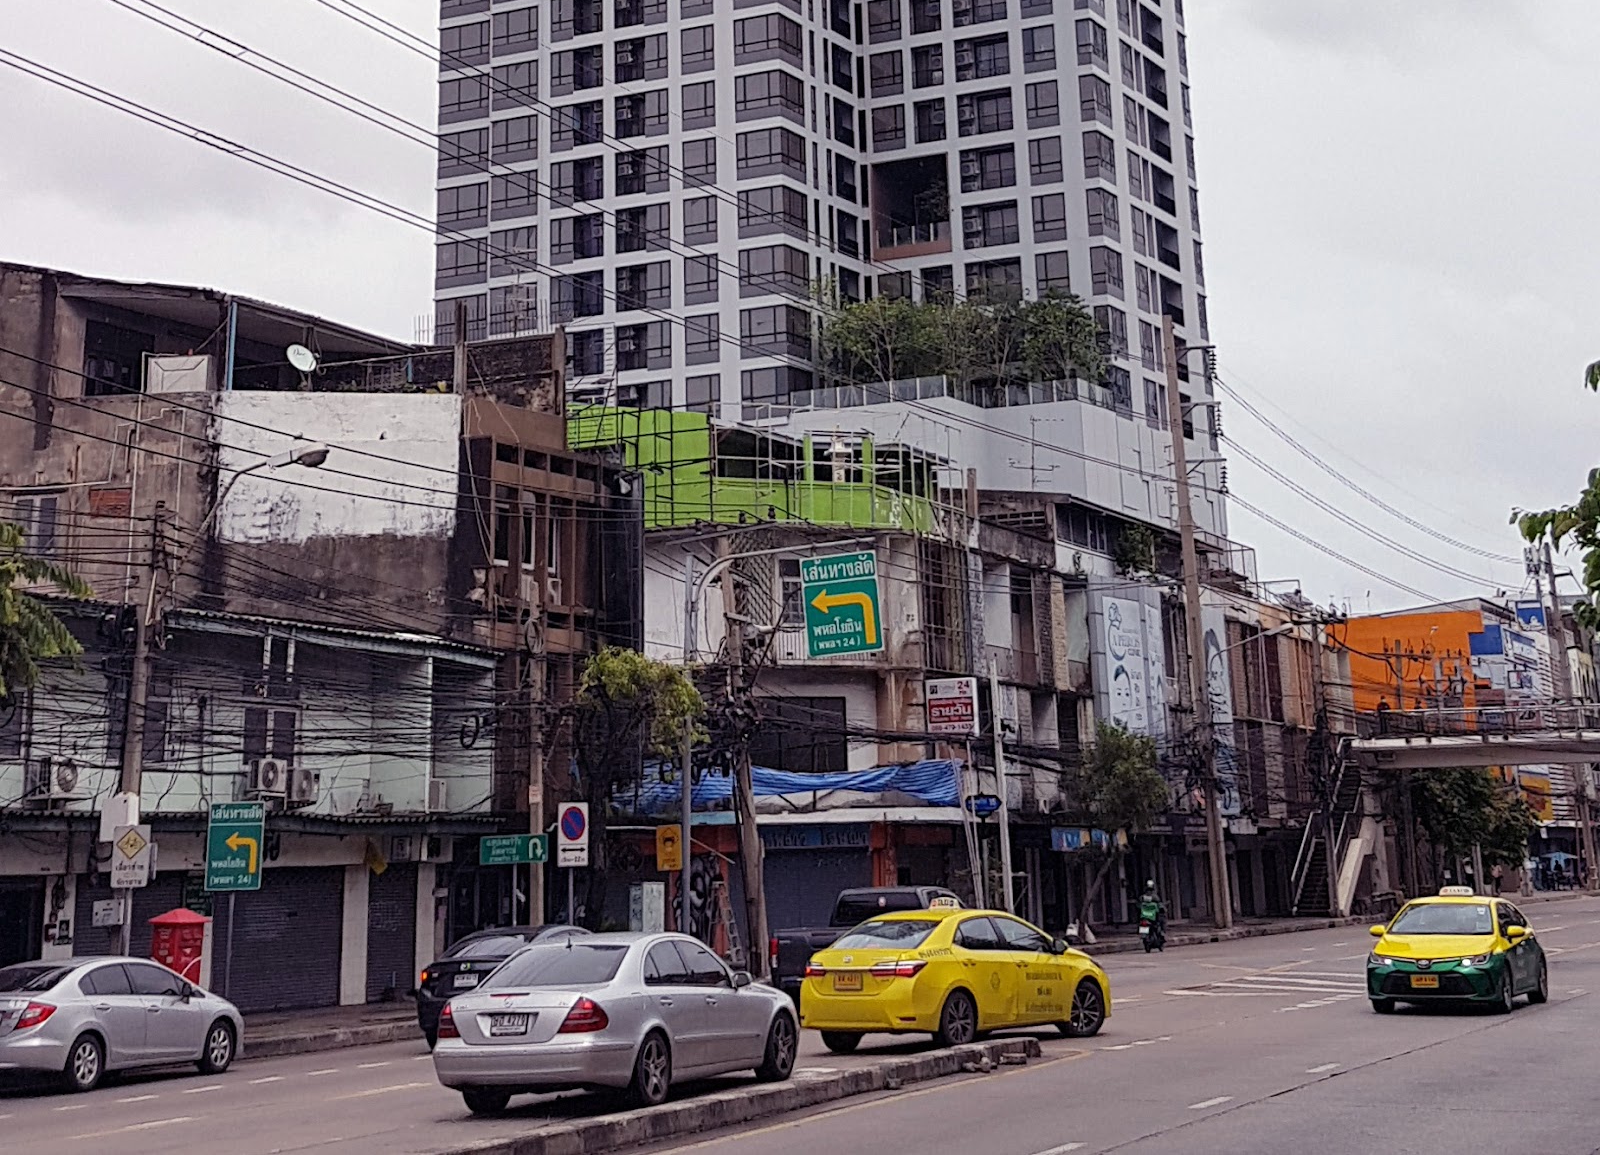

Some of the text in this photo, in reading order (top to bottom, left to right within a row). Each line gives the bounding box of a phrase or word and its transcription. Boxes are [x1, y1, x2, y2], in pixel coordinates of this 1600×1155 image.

[803, 554, 874, 582] เส้นทางลัด
[813, 616, 862, 636] พหลโยธิน
[931, 703, 972, 717] รายวัน
[211, 804, 263, 819] เส้นทางลัด
